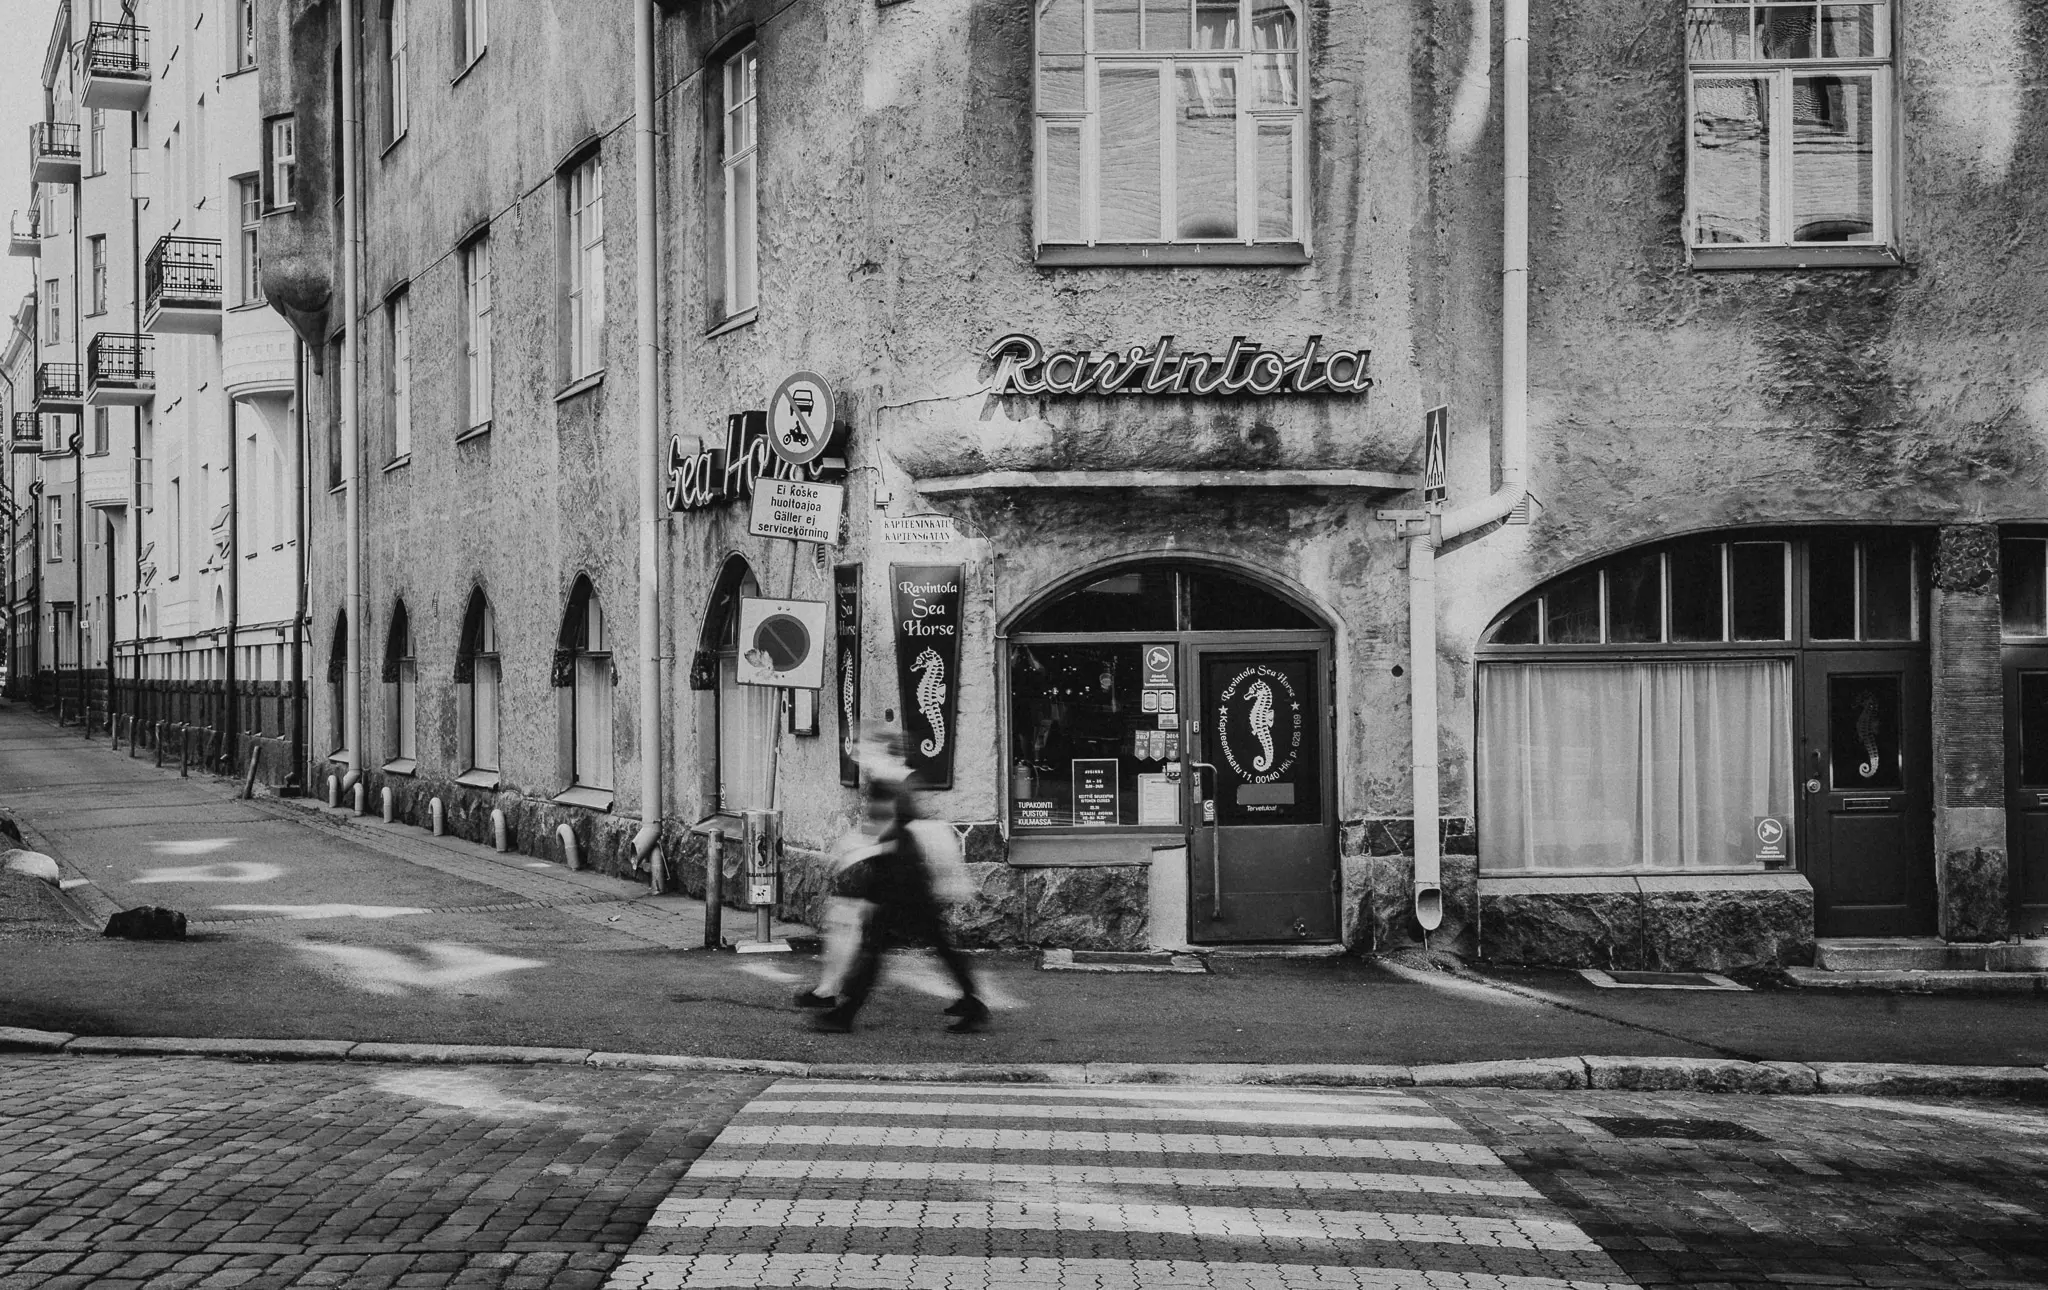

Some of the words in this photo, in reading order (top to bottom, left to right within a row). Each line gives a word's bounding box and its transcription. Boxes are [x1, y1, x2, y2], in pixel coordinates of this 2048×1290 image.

[987, 334, 1374, 395] Ravintola
[666, 433, 714, 511] Sea
[776, 484, 787, 495] Ei
[789, 485, 819, 499] koske
[770, 496, 822, 512] huoltoajoa
[773, 510, 802, 523] Gäller
[805, 515, 817, 526] ej
[884, 519, 951, 529] KAPTEENINKATU
[757, 521, 829, 540] servicekörning
[885, 532, 950, 541] KAPTENSGATAN
[898, 581, 958, 597] Ravintola
[911, 598, 946, 618] Sea
[902, 620, 955, 636] Horse
[1221, 666, 1256, 702] Ravintola
[1257, 664, 1277, 677] Sea
[1277, 672, 1296, 698] Horse
[1293, 714, 1302, 729] 169
[1218, 715, 1243, 775] Kapteeninkatu
[1291, 731, 1302, 747] 628
[1255, 772, 1280, 784] 00140
[1018, 801, 1053, 809] TUPAKOINTI
[1018, 818, 1052, 826] KULMASSA
